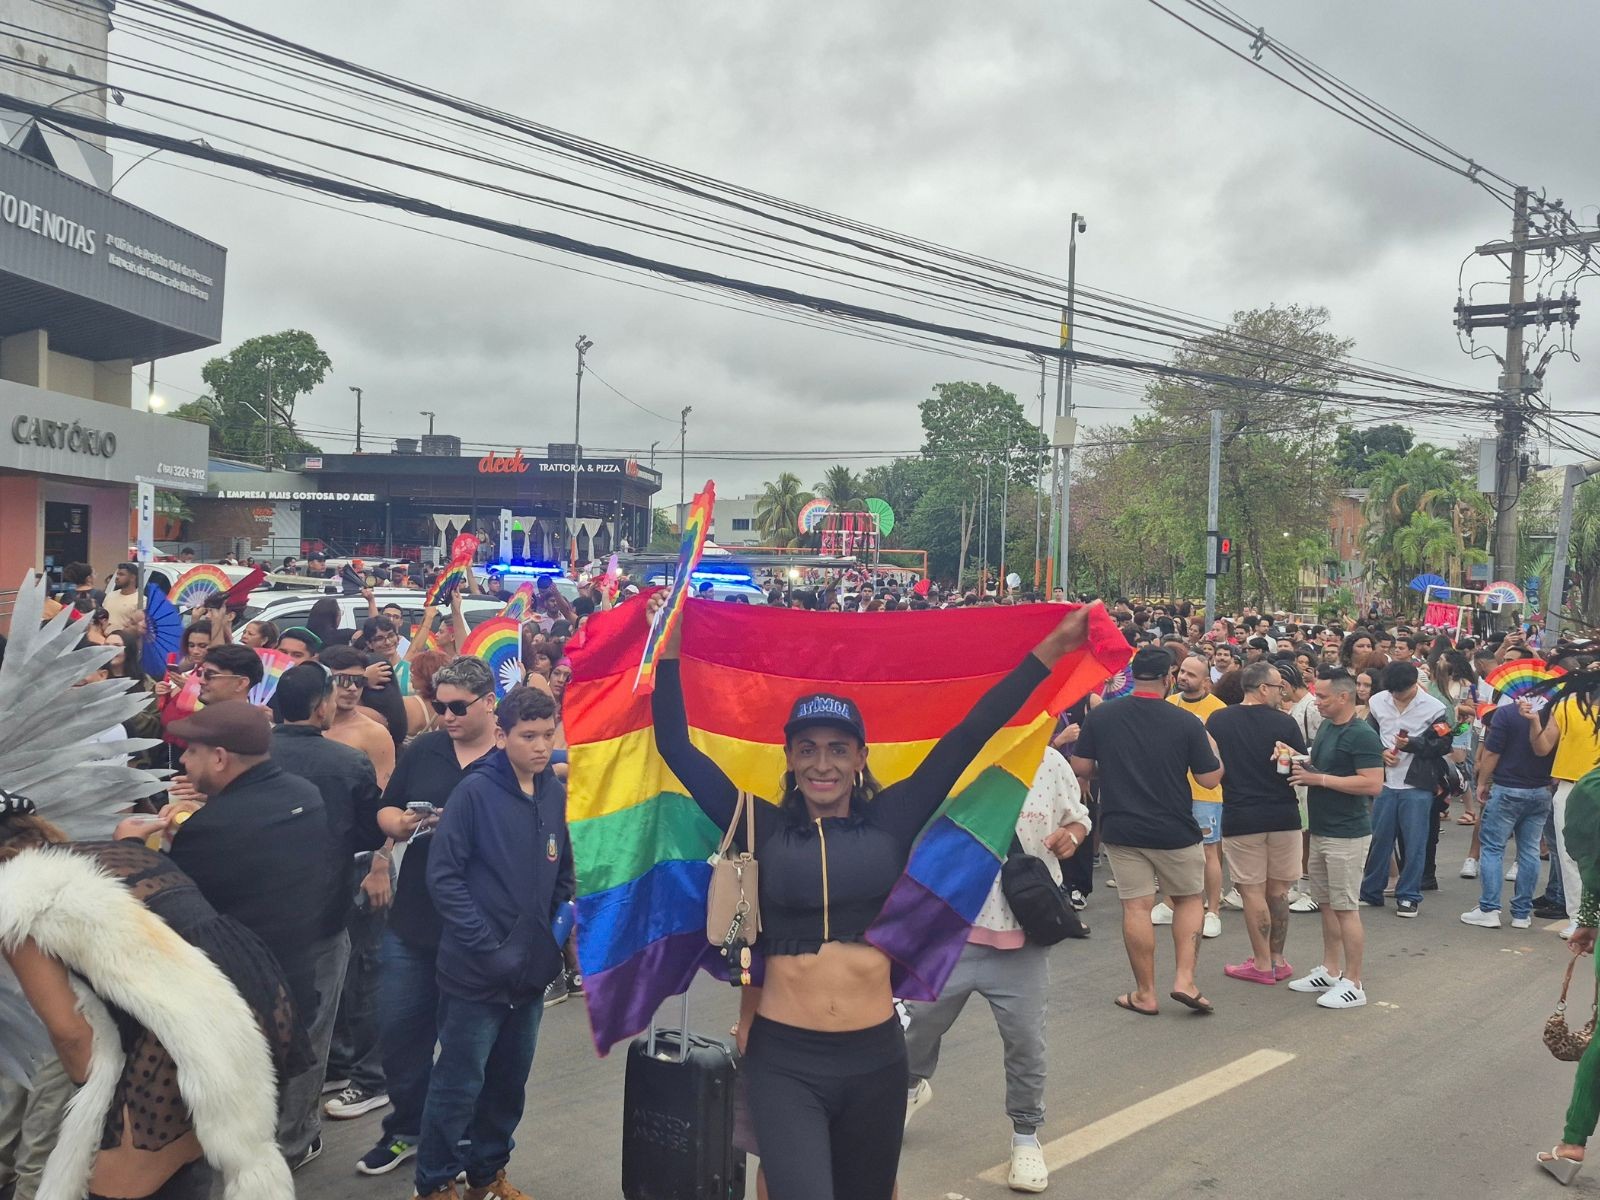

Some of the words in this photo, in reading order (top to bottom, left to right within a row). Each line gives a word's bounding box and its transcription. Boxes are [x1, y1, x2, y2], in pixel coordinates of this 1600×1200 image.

[18, 200, 42, 234] DE
[42, 210, 96, 255] NOTAS
[12, 415, 117, 458] CARTÓRIO
[478, 448, 530, 473] deck
[539, 463, 585, 473] TRATTORA
[587, 464, 594, 473] &
[596, 464, 621, 473] PIZZA
[217, 490, 225, 499] A
[226, 490, 267, 499] EMPRESA
[268, 491, 291, 500] MAIS
[292, 491, 335, 500] GOSTOSA
[336, 493, 351, 501] DO
[352, 493, 376, 502] ACRE
